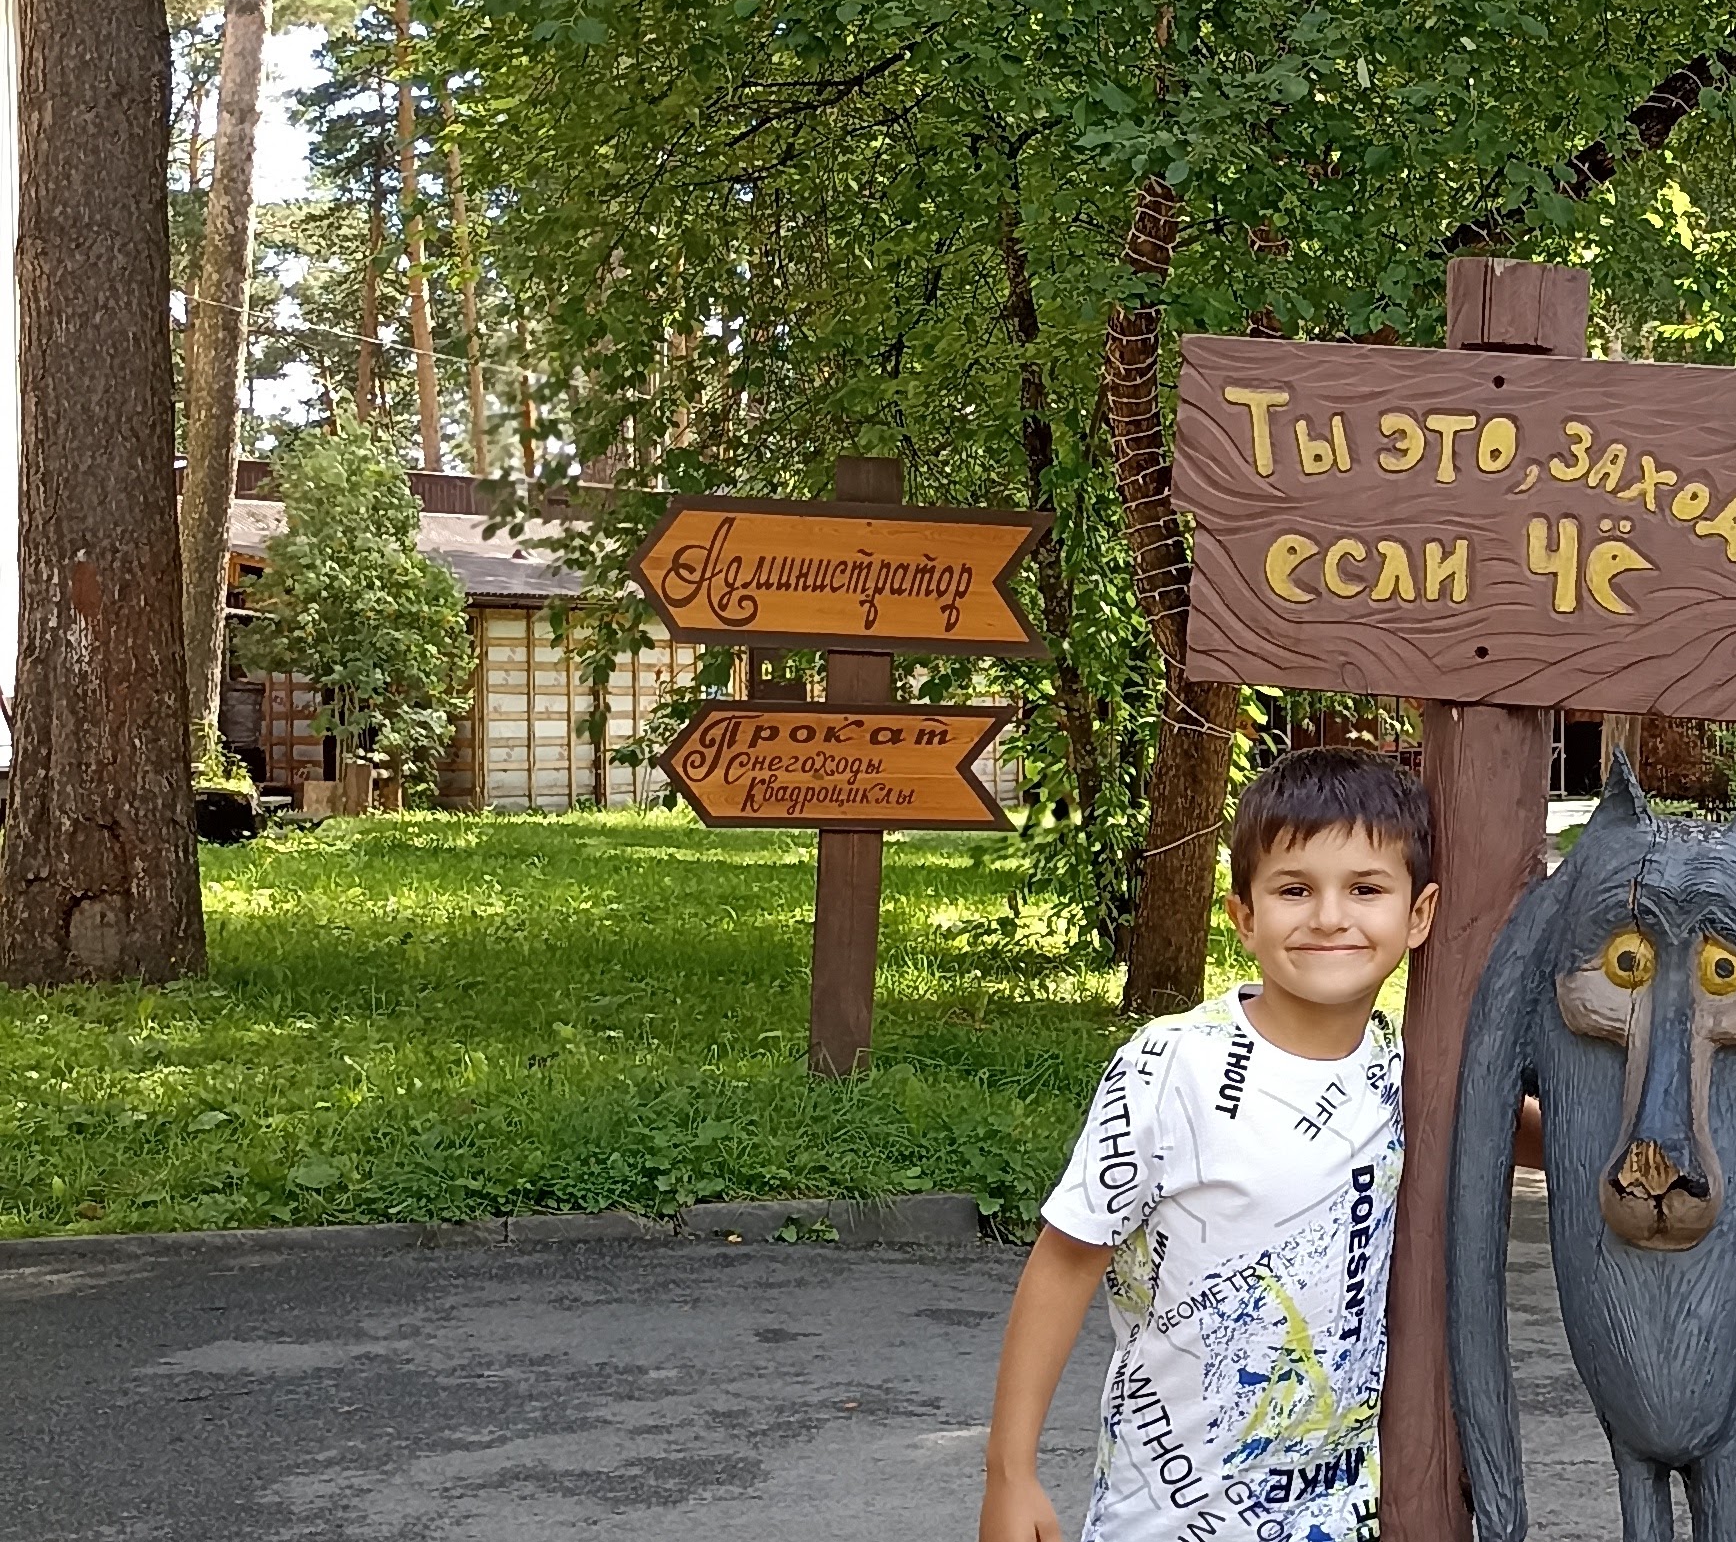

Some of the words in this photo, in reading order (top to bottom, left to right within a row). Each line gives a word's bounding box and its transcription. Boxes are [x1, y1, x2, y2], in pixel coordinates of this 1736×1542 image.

[661, 516, 973, 634] Администратор
[682, 713, 956, 783] Прокат
[723, 750, 883, 786] Снегоходы
[740, 776, 915, 816] Квадроциклы
[1293, 1081, 1347, 1142] LIFE
[1339, 1164, 1375, 1343] DOESN'T
[1155, 1250, 1275, 1336] GEOMETRY
